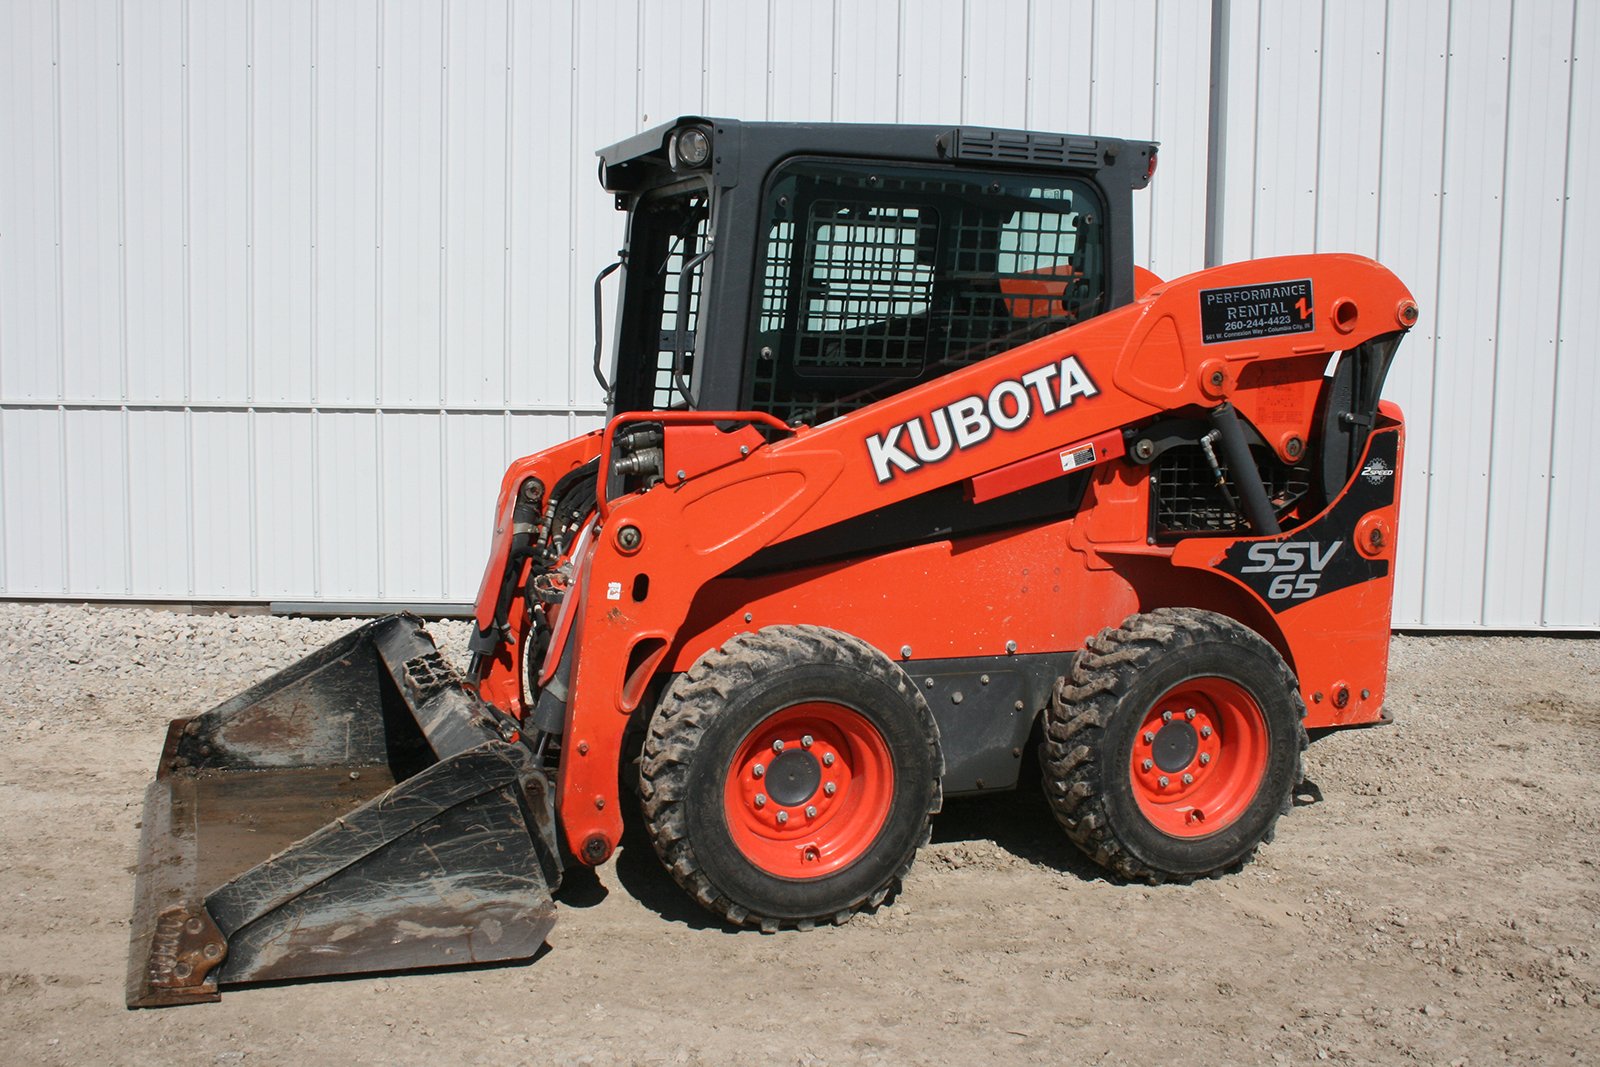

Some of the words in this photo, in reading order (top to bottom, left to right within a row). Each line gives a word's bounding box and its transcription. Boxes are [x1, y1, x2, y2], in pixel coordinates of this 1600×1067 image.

[1207, 285, 1306, 305] PERFORMANCE
[1227, 302, 1288, 320] RENTAL
[1224, 329, 1252, 338] Connexion
[1252, 328, 1264, 336] Way
[1268, 324, 1292, 333] Columbia
[1225, 315, 1291, 331] 260-244-4423
[865, 355, 1099, 483] KUBOTA
[1240, 540, 1343, 573] SSV
[1267, 573, 1321, 600] 65
